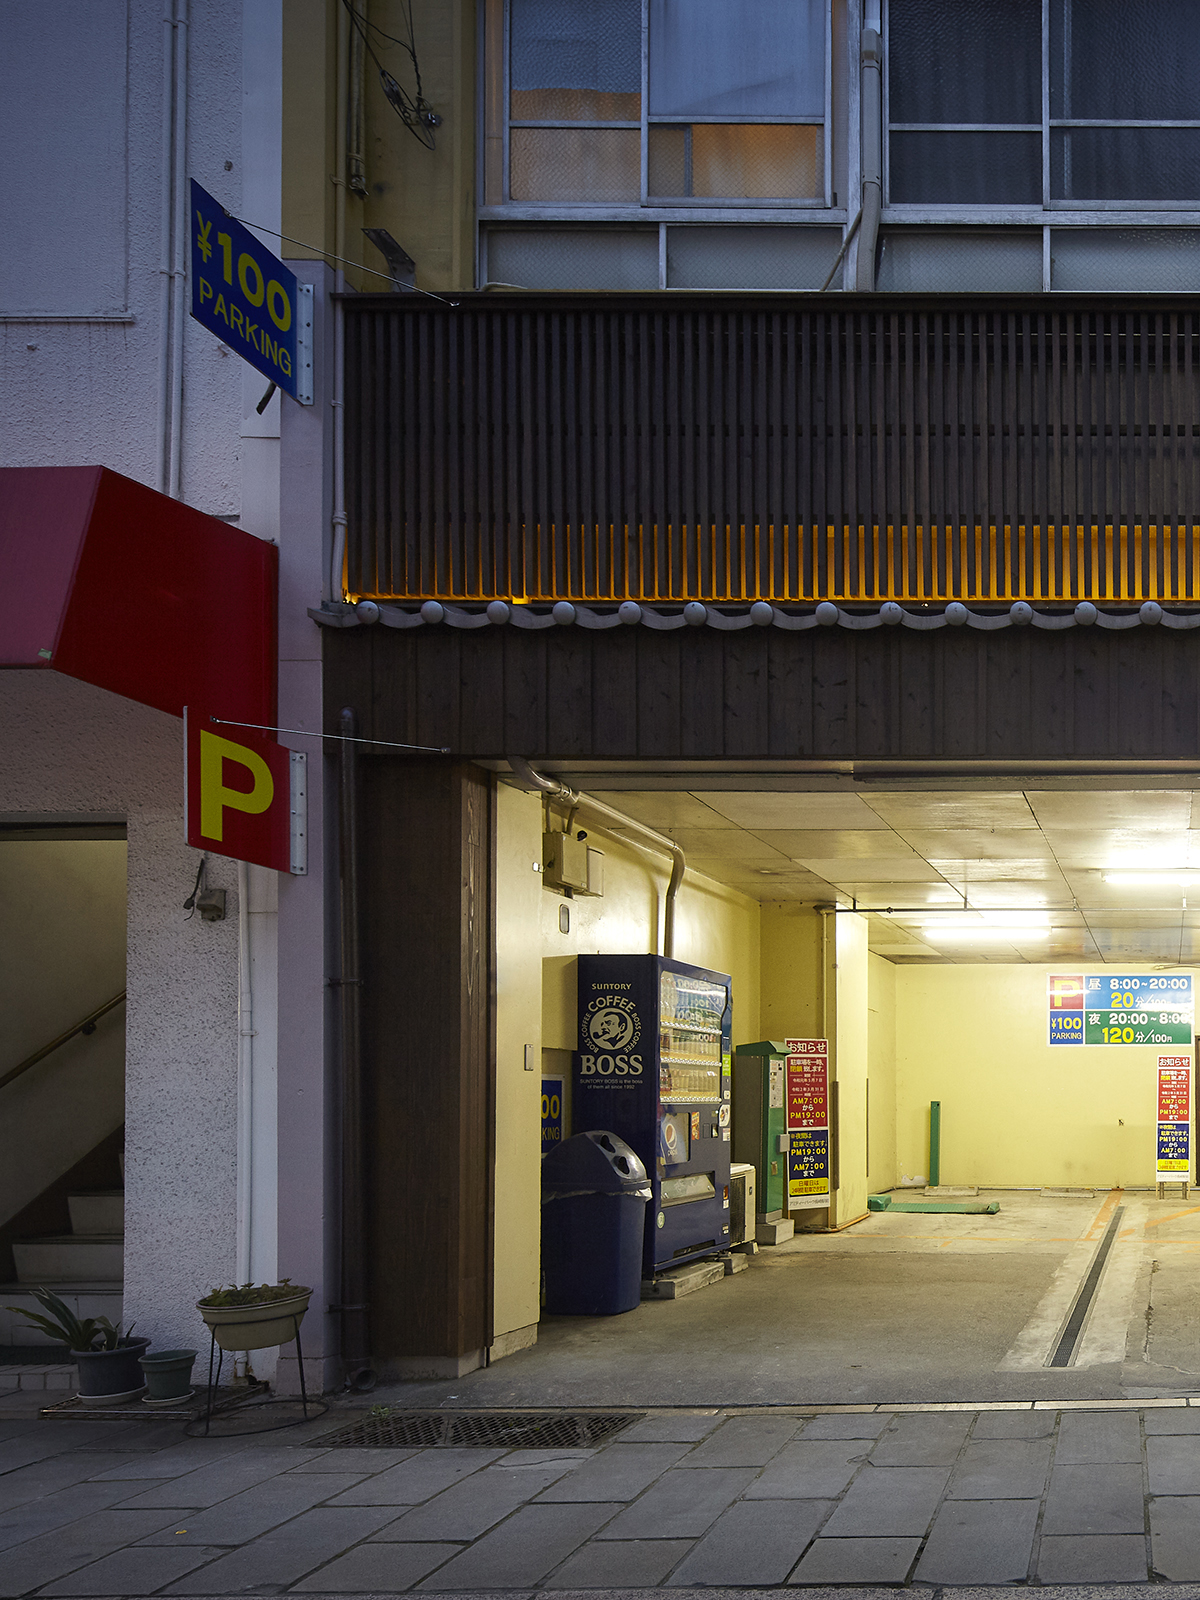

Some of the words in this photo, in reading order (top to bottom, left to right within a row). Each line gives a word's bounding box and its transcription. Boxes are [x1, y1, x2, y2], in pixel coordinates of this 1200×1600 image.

[196, 210, 291, 332] ¥100
[200, 276, 291, 378] PARKING
[201, 729, 274, 842] P
[1088, 978, 1101, 990] 昼
[1054, 980, 1080, 1007] P
[588, 995, 636, 1013] COFFEE
[581, 1013, 592, 1037] COFFEE
[631, 1012, 642, 1030] BOSS
[1052, 1017, 1082, 1029] ¥100
[1088, 1013, 1101, 1025] 夜
[623, 1031, 641, 1054] COFFEE
[1052, 1032, 1082, 1040] PARKING
[788, 1042, 826, 1053] お知らせ
[580, 1055, 643, 1075] BOSS
[790, 1111, 826, 1119] PM19:00
[791, 1148, 826, 1156] PM19:00
[794, 1163, 824, 1171] AM7:00
